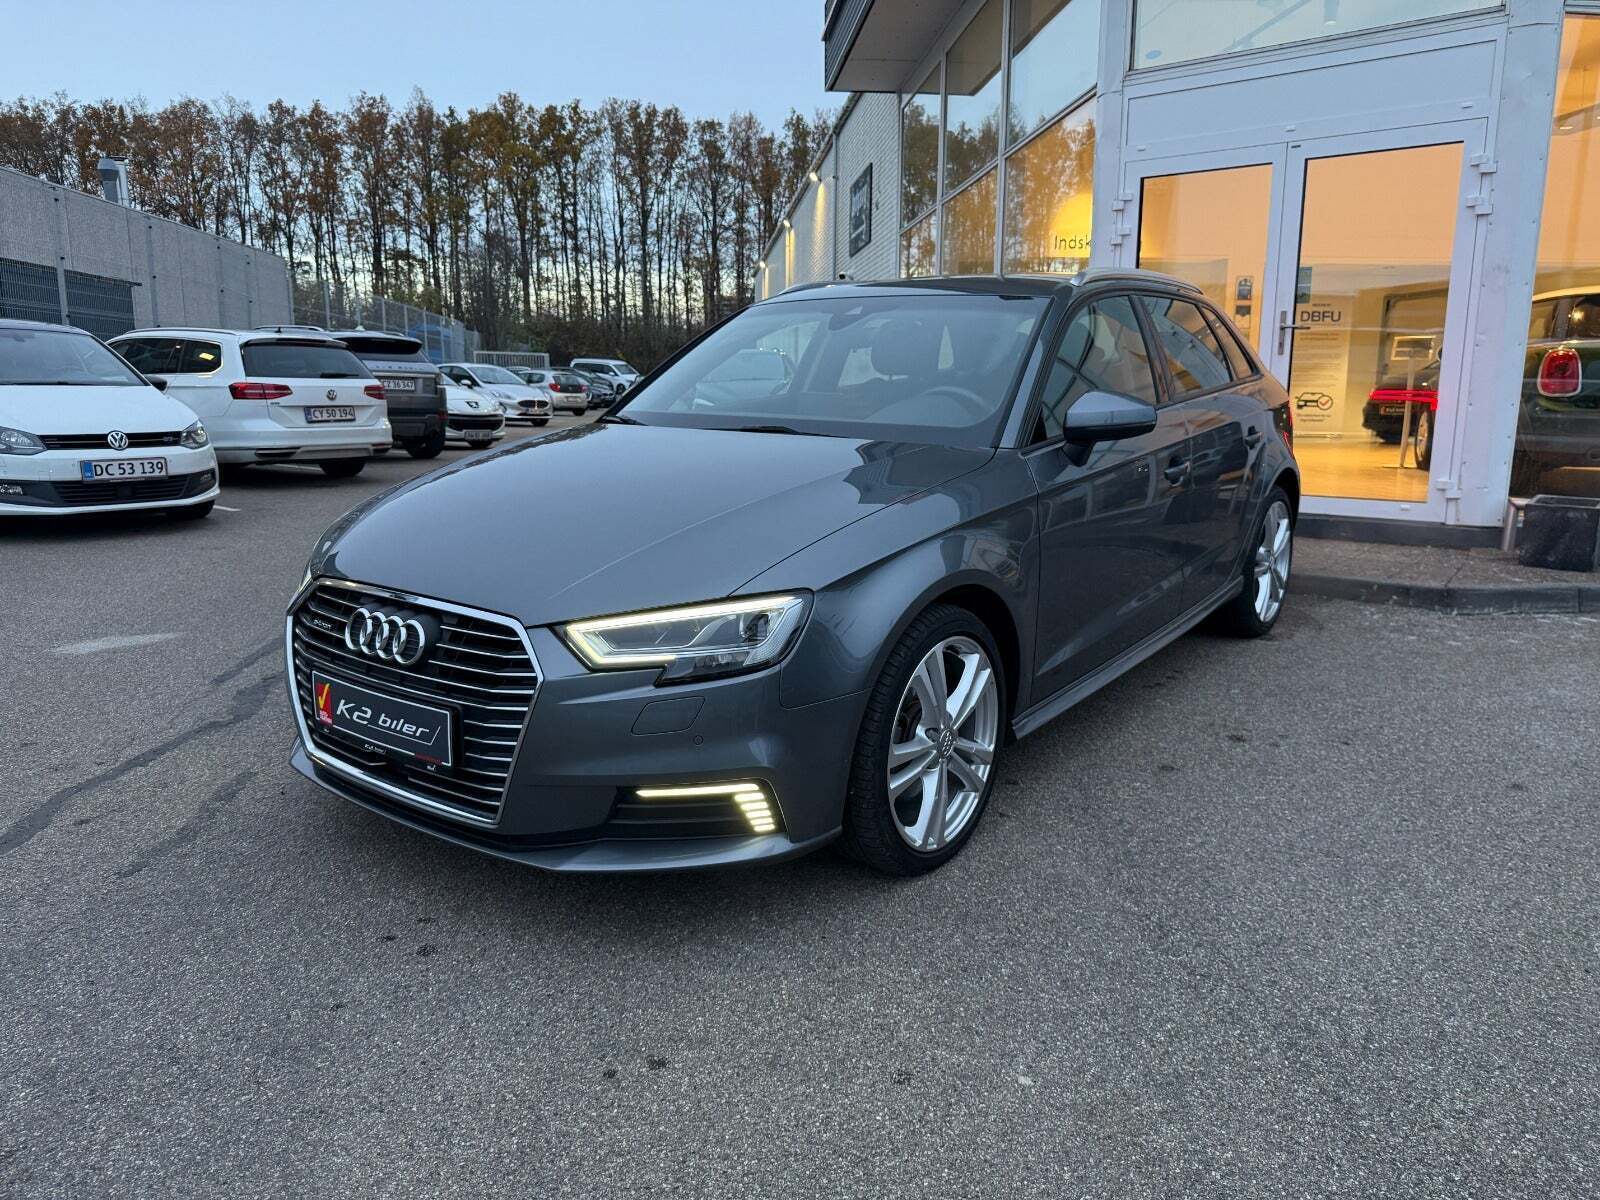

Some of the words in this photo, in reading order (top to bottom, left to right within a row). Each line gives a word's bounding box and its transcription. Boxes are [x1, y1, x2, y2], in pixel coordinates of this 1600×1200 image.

[1300, 310, 1341, 322] DBFU
[312, 407, 324, 418] CY
[326, 408, 337, 418] 50
[339, 407, 354, 418] 194
[93, 463, 115, 477] DC
[118, 462, 136, 475] 53
[140, 461, 164, 475] 139
[336, 699, 372, 725] K2
[378, 712, 430, 737] biler
